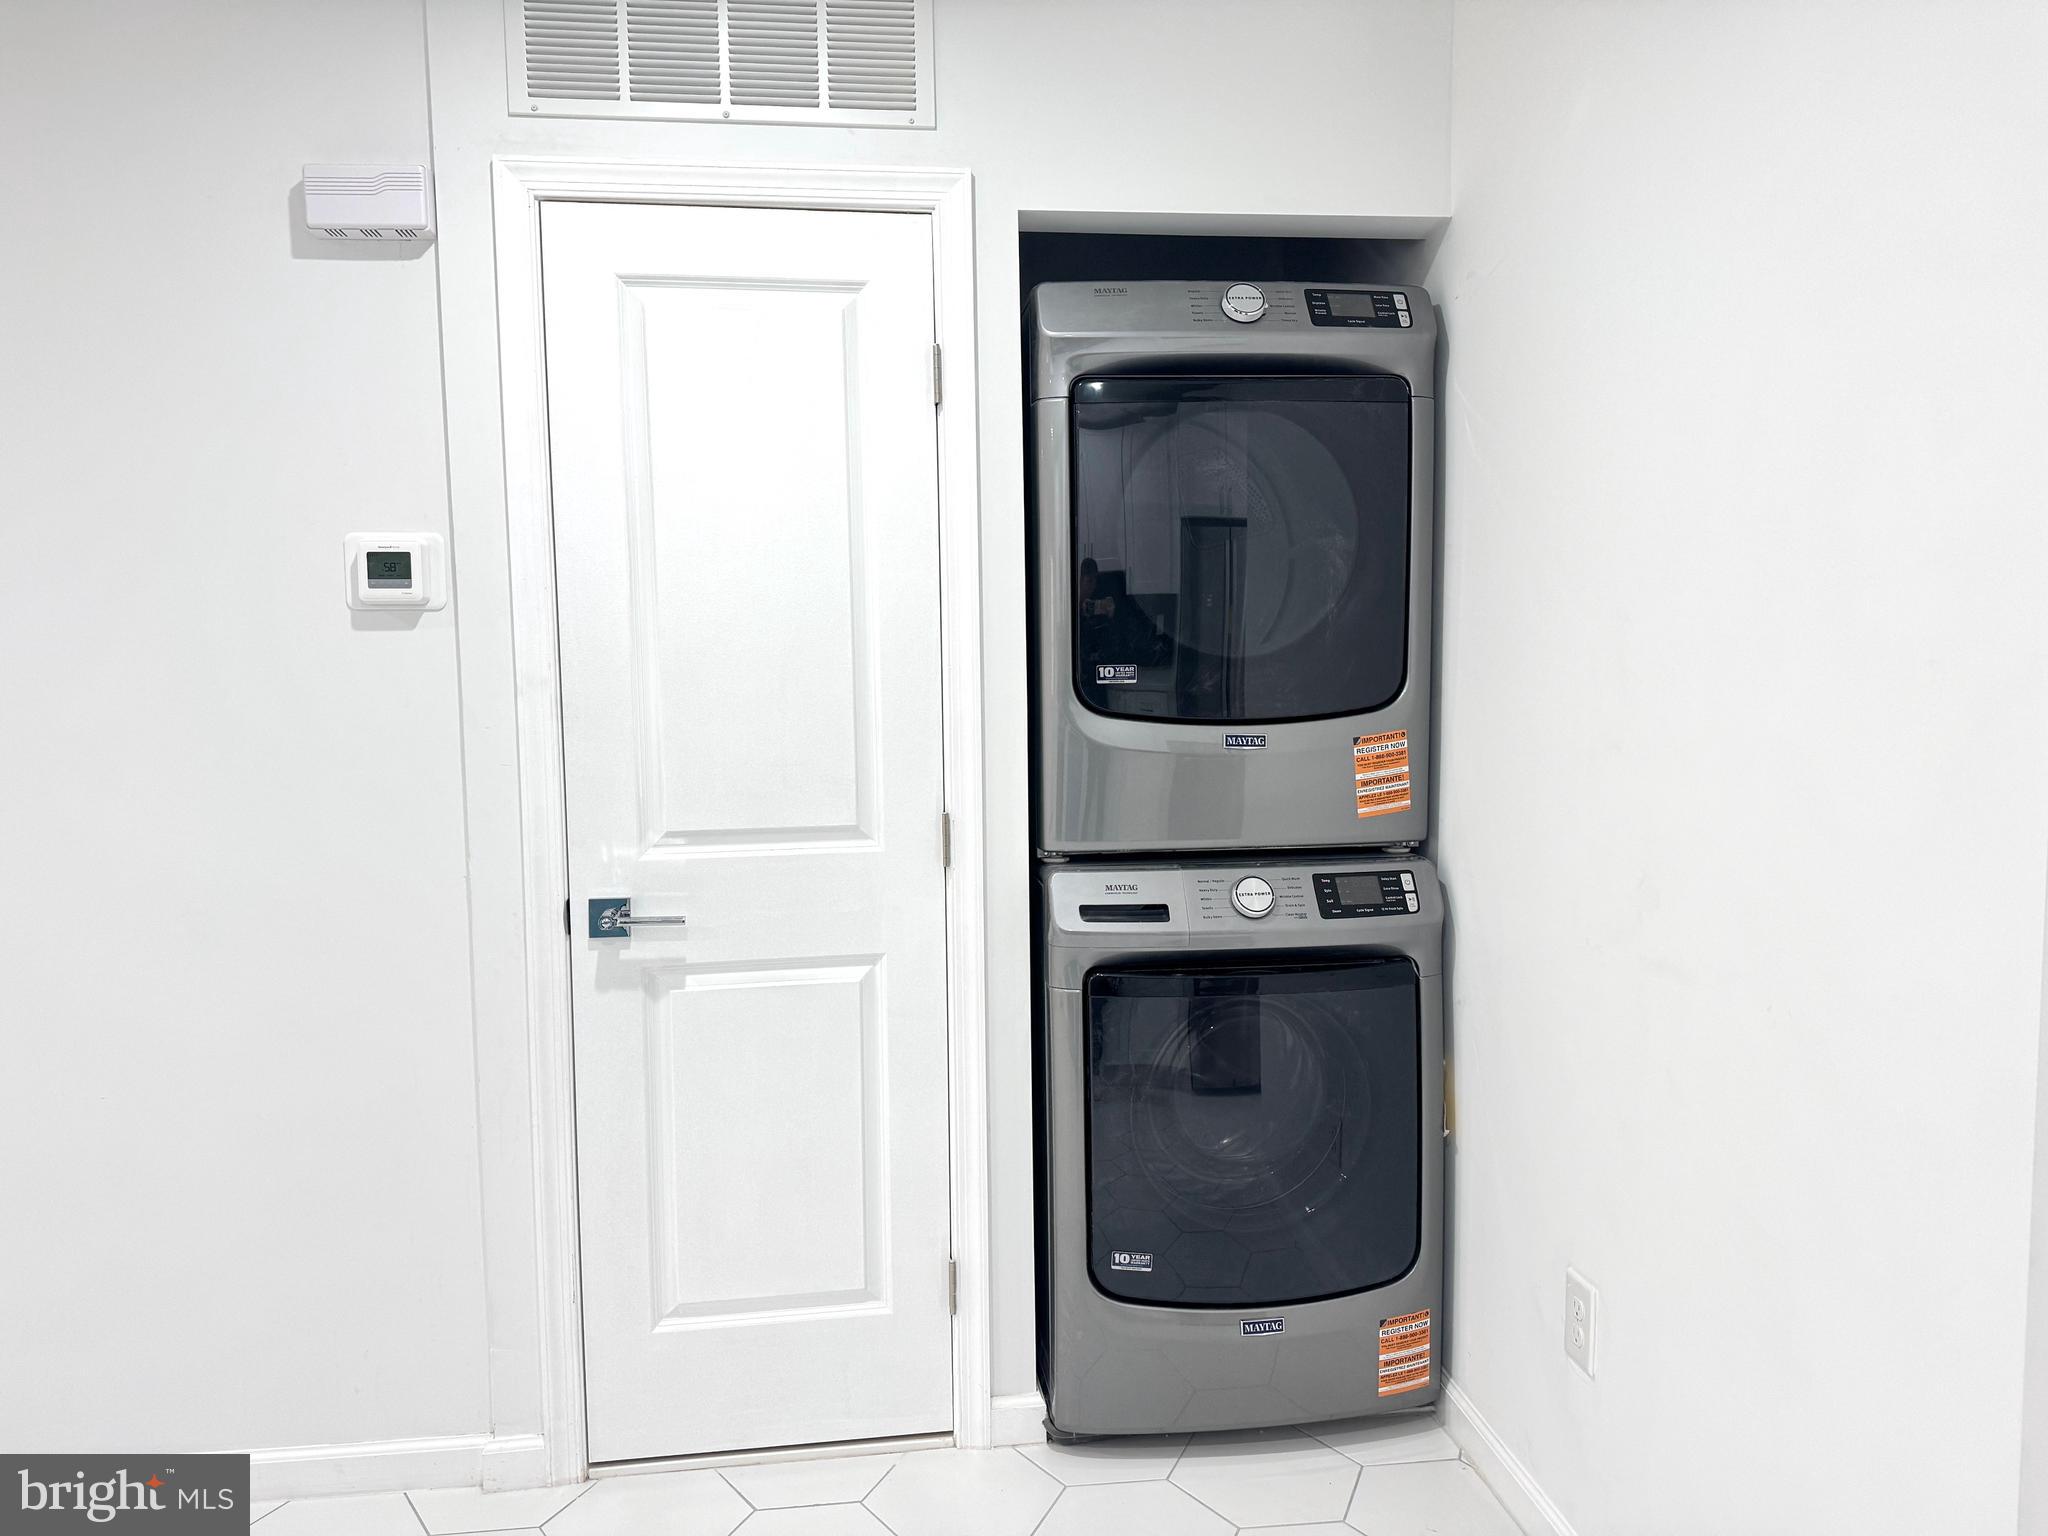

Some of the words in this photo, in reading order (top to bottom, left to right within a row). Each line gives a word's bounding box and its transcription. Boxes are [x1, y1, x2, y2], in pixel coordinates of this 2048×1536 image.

[1099, 667, 1114, 678] 10
[1227, 737, 1265, 745] MAYTAG
[1356, 744, 1390, 755] REGISTER
[1390, 741, 1406, 749] NOW
[1356, 755, 1370, 763] CALL
[1114, 1253, 1130, 1264] 10
[1244, 1321, 1282, 1333] MAYTAG
[1381, 1324, 1414, 1336] REGISTER
[1414, 1320, 1429, 1329] NOW
